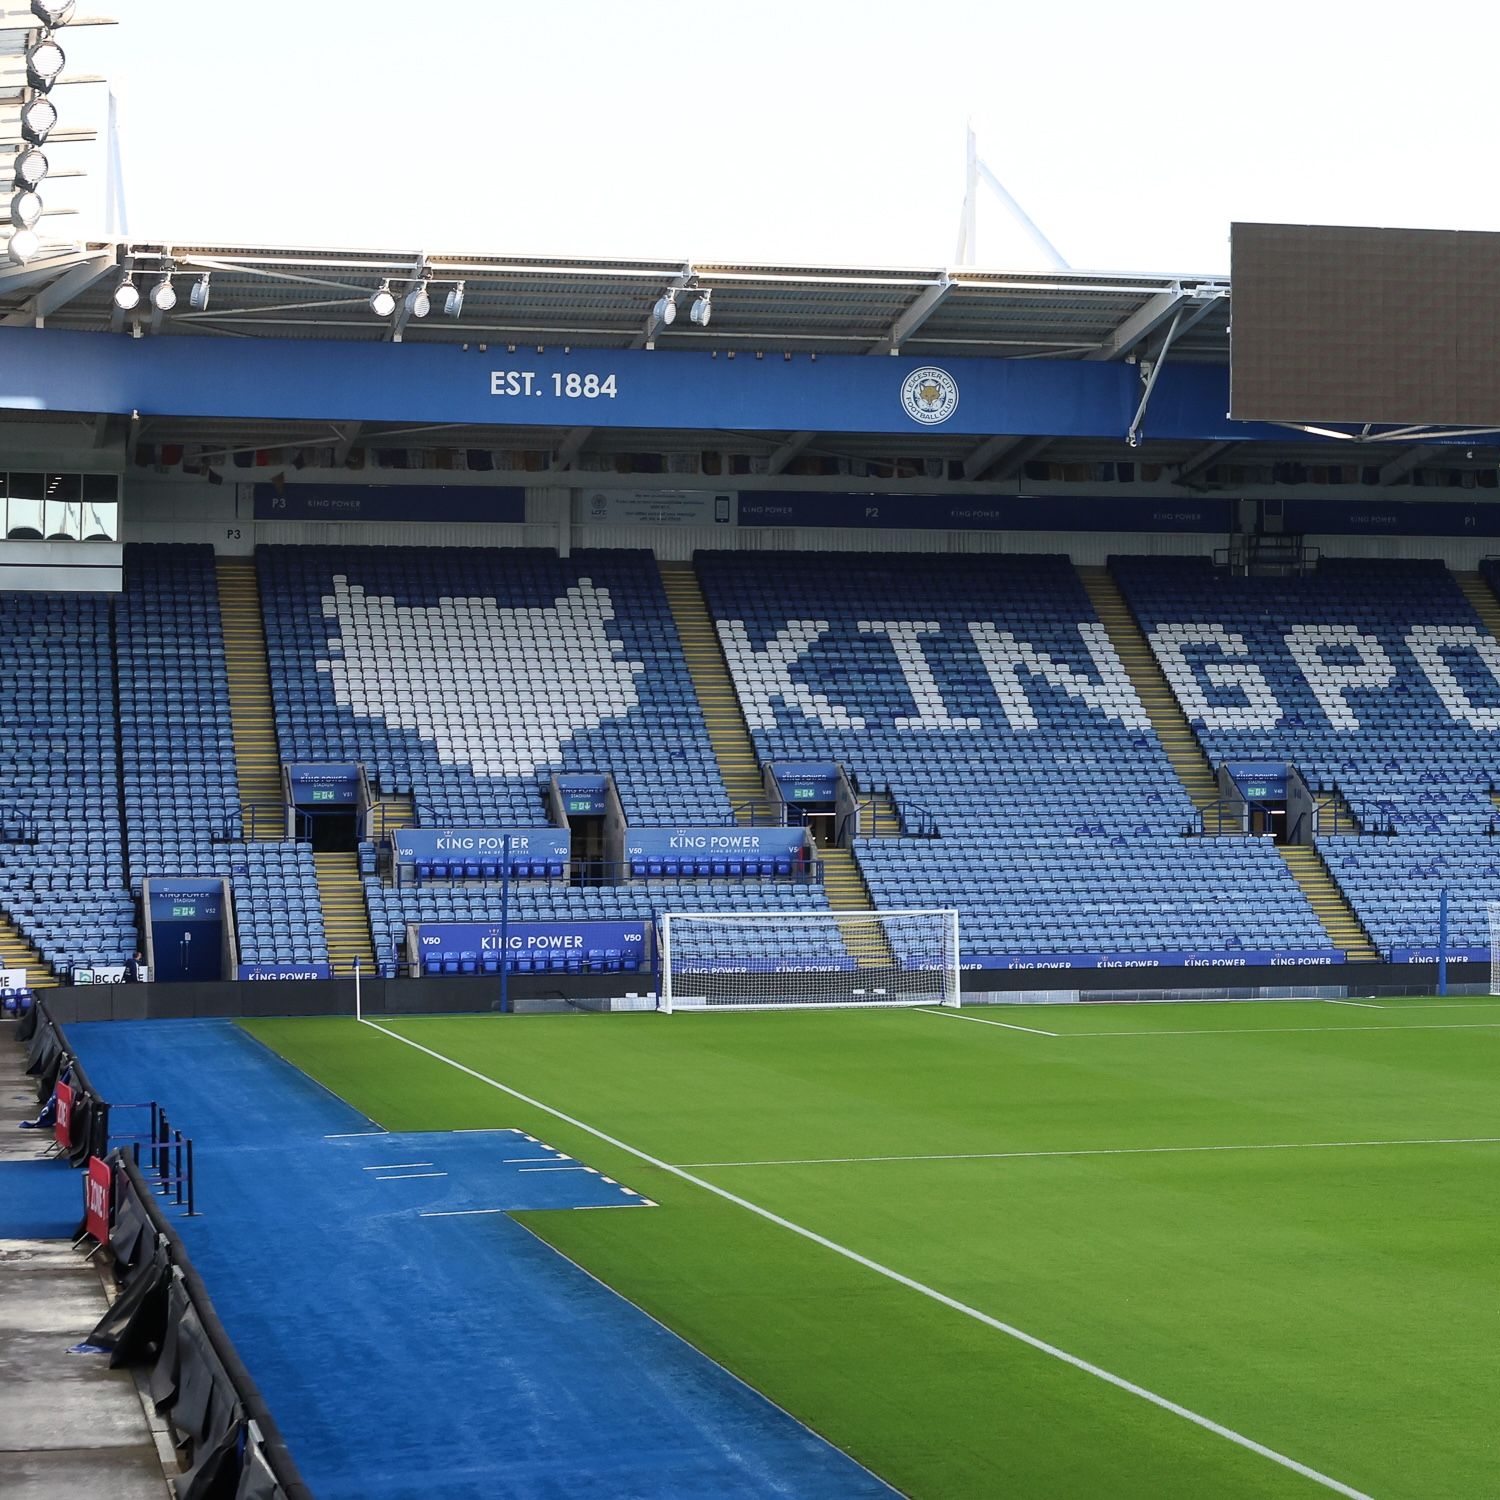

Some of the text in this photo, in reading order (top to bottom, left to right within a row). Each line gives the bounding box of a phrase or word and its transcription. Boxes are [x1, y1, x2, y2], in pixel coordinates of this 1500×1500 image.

[491, 371, 617, 398] EST. 1884
[907, 371, 954, 394] LEICESTER CITY
[907, 397, 954, 420] FOOTBALL CLUB
[272, 498, 287, 508] P3
[866, 508, 879, 517] P2
[1464, 517, 1475, 526] P1
[227, 529, 241, 540] P3
[437, 838, 474, 849] KING
[670, 836, 760, 848] KING POWER
[481, 936, 583, 949] KING POWER
[248, 972, 318, 981] KING POWER
